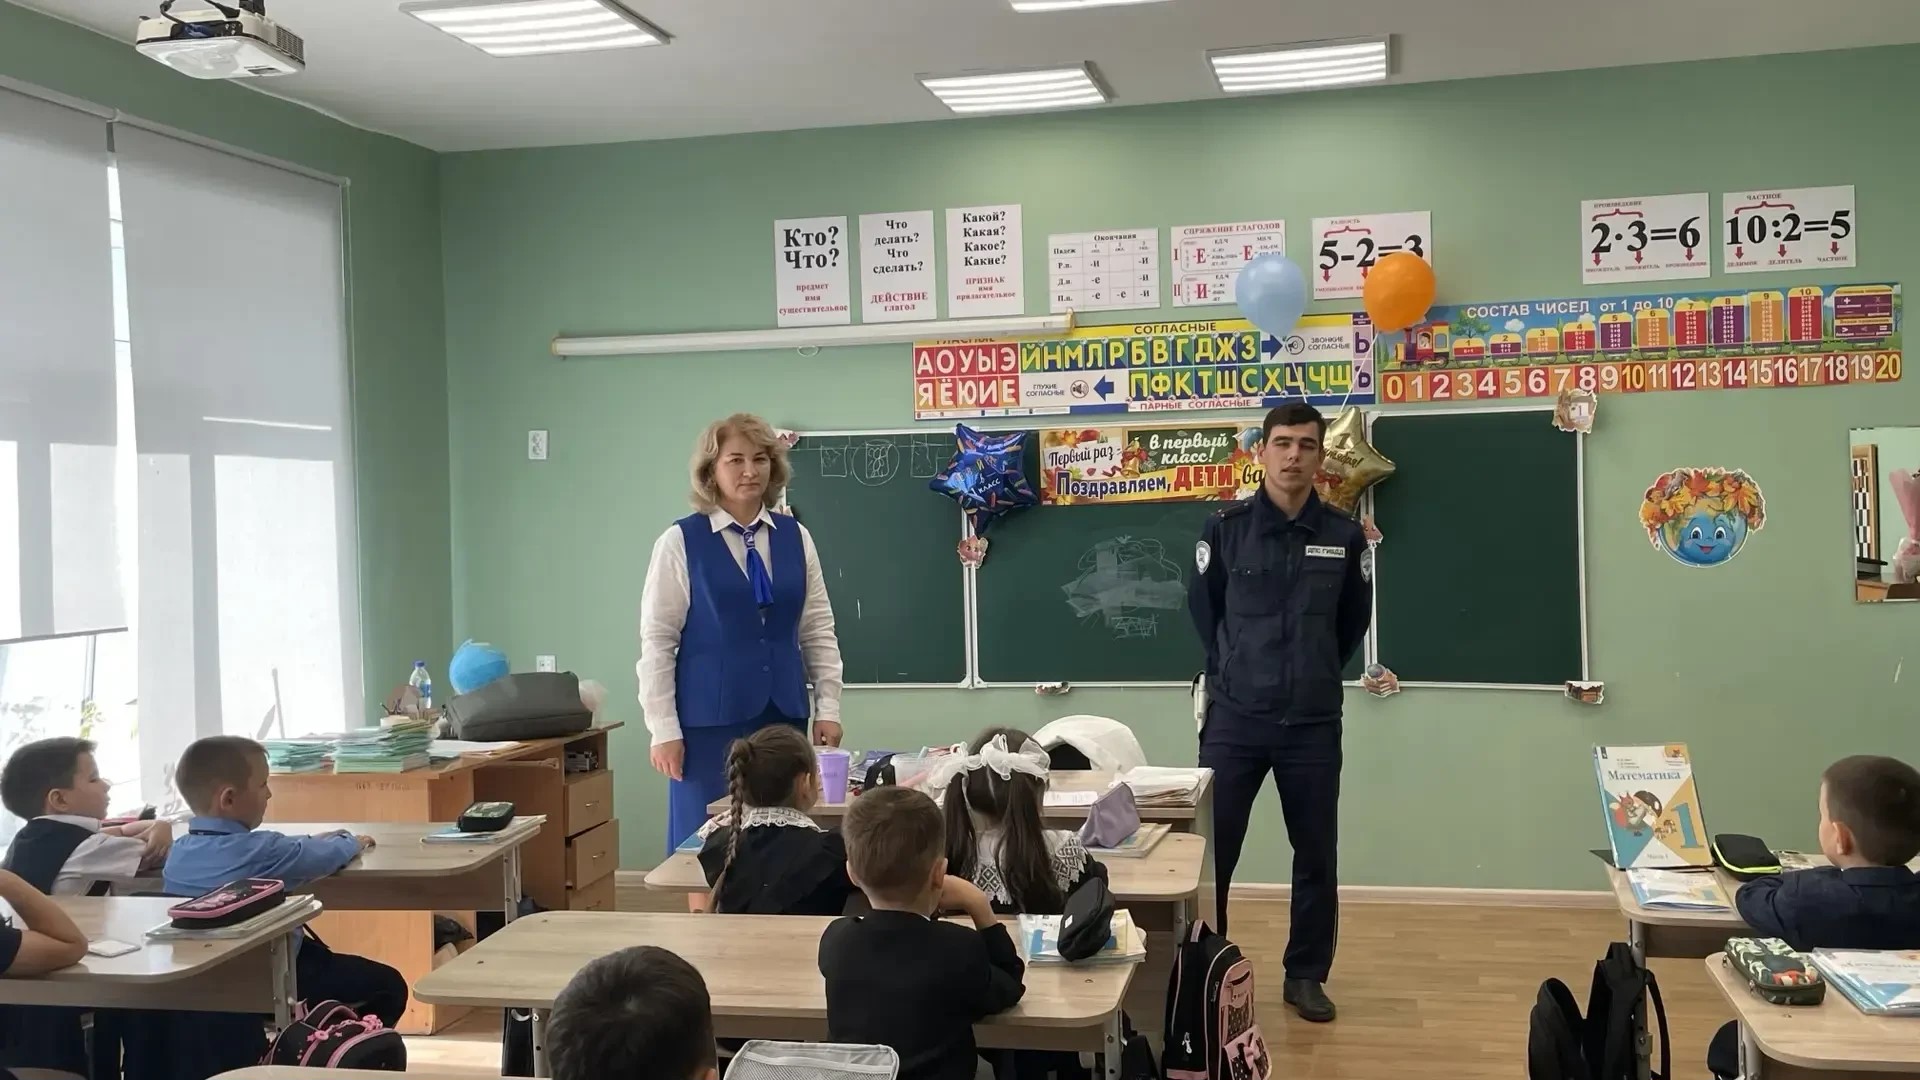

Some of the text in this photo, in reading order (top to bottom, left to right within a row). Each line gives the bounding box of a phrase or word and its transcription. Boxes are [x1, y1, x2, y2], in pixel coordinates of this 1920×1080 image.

[962, 211, 1006, 223] Какой?
[886, 219, 908, 229] Что
[1183, 222, 1280, 235] СПРЯЖЕНИЕ ГЛАГОЛОВ
[783, 226, 839, 248] Кто?
[963, 226, 1006, 237] Какая?
[874, 232, 920, 246] делать?
[964, 240, 1006, 252] Какое?
[783, 248, 840, 269] Что?
[887, 248, 909, 258] Что
[964, 255, 1007, 266] Какие?
[873, 261, 923, 274] сделать?
[965, 276, 1005, 285] ПРИЗНАК
[796, 283, 829, 292] предмет
[870, 292, 928, 304] ДЕЙСТВИЕ
[956, 292, 1016, 301] прилагательное
[779, 304, 848, 315] существительное
[884, 304, 915, 312] глагол
[1466, 297, 1674, 319] СОСТАВ ЧИСЕЛ от 1 до 10
[1134, 322, 1217, 335] СОГЛАСНЫЕ
[1308, 343, 1351, 351] СОГЛАСНЫЕ
[1386, 353, 1901, 400] 0 1 2 3 4 5 6 7 8 9 10 11 12 13 14 15 16 17 18 19 20
[1026, 389, 1065, 397] СОГЛАСНЫЕ
[1140, 400, 1251, 410] ПАРНЫЕ СОГЛАСНЫЕ
[1149, 432, 1230, 454] в первый
[1049, 449, 1092, 468] Первый
[1093, 445, 1114, 464] раз
[1160, 447, 1214, 465] класс!
[1055, 470, 1172, 500] Поздравляем,
[1241, 463, 1265, 486] ва
[1608, 770, 1681, 781] Математика
[1671, 802, 1705, 849] 1
